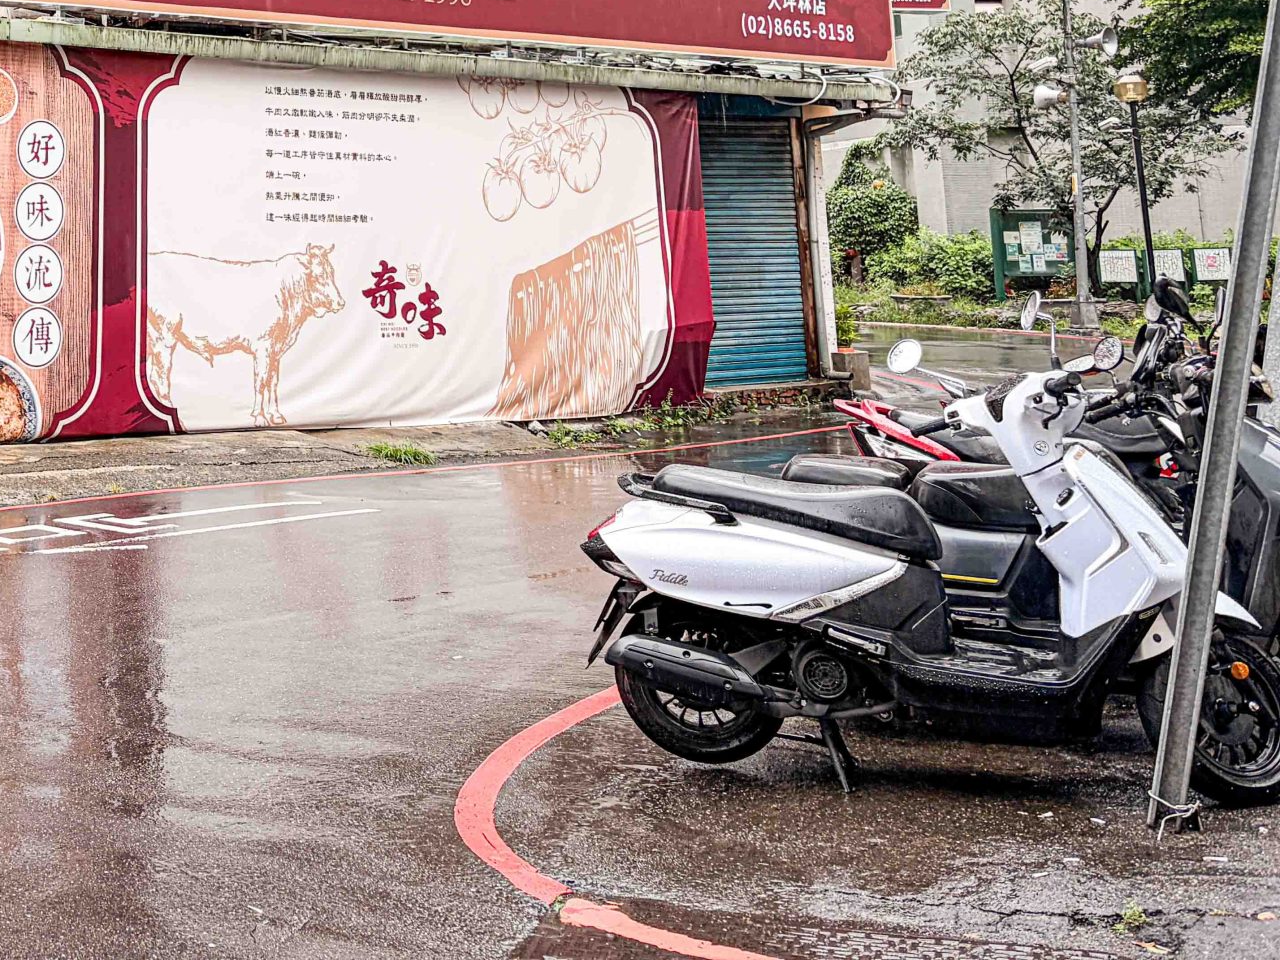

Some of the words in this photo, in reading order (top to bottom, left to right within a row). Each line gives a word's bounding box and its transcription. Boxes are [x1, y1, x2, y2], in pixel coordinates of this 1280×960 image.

[741, 12, 855, 43] (02)8665-8158
[26, 133, 56, 355] 好味流傳
[362, 260, 447, 340] 奇味
[649, 568, 689, 587] Fiddle
